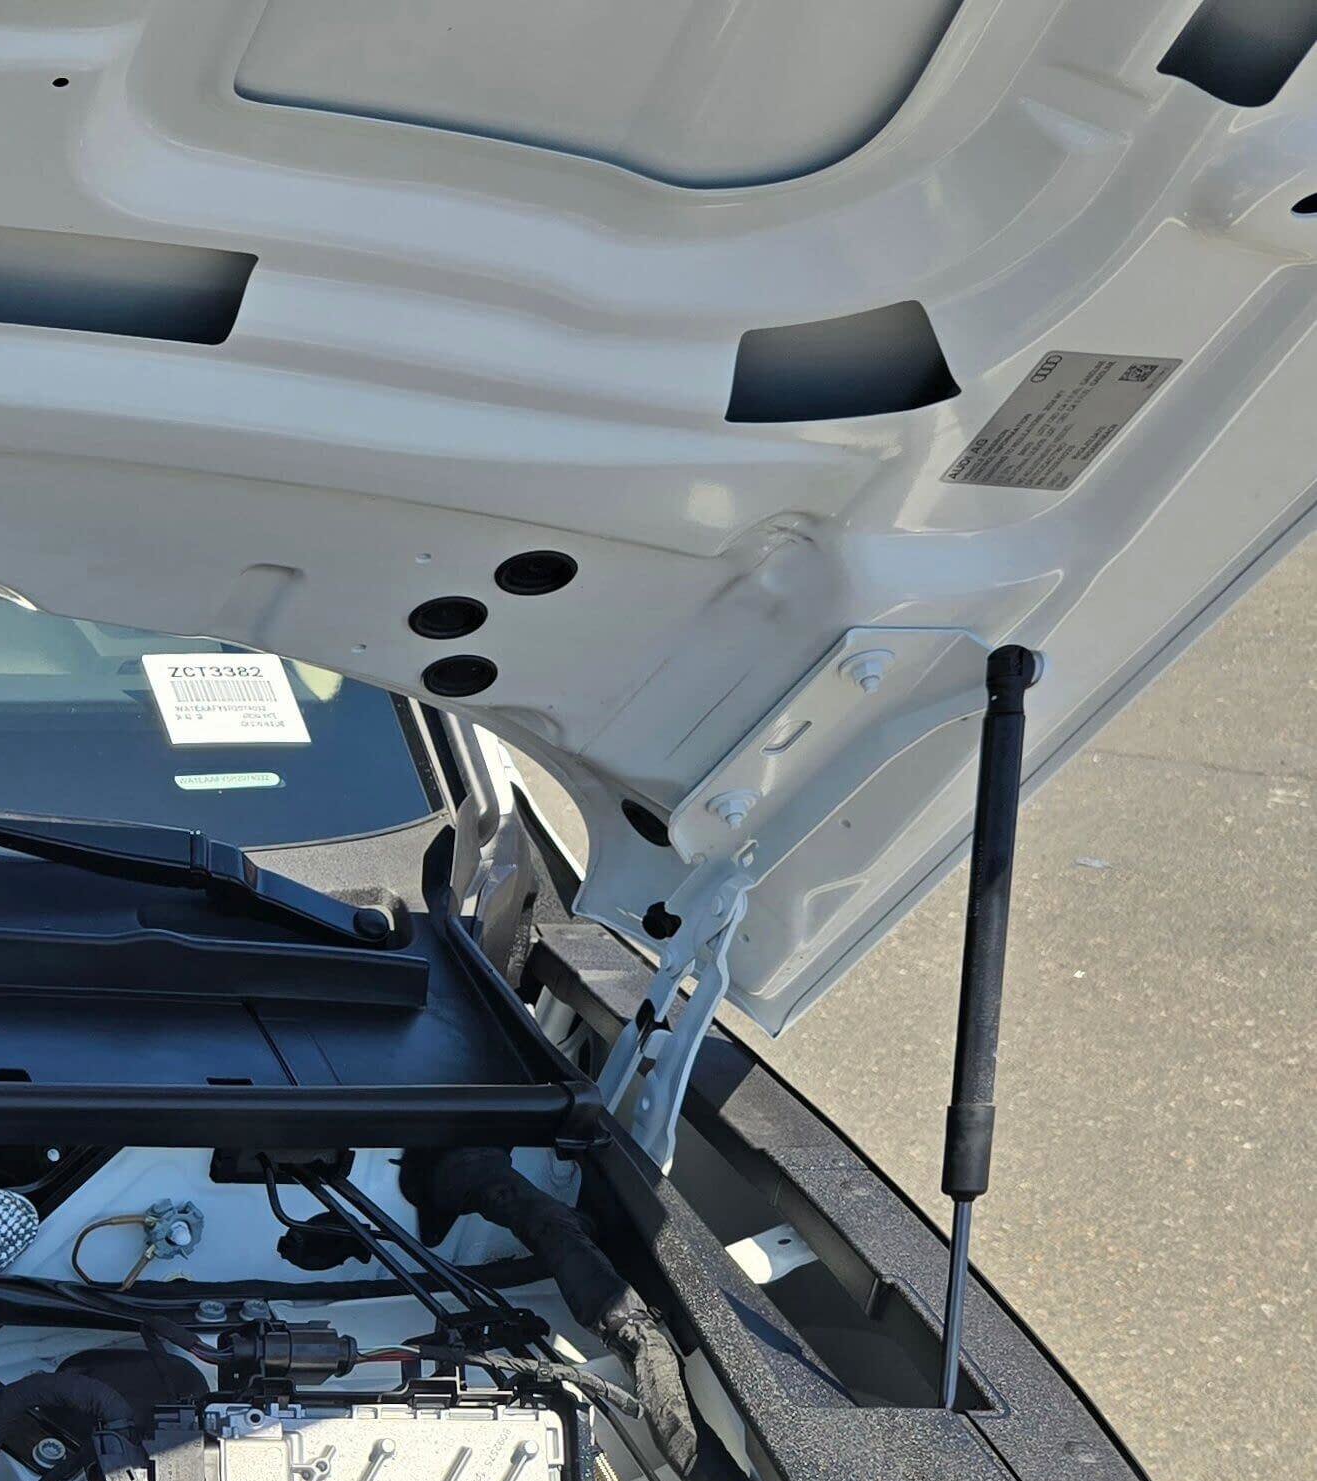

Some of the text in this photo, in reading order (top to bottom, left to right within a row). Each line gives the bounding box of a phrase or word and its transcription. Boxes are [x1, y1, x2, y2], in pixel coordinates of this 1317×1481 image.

[949, 438, 989, 480] AUDI AG
[167, 666, 264, 678] ZCT3382
